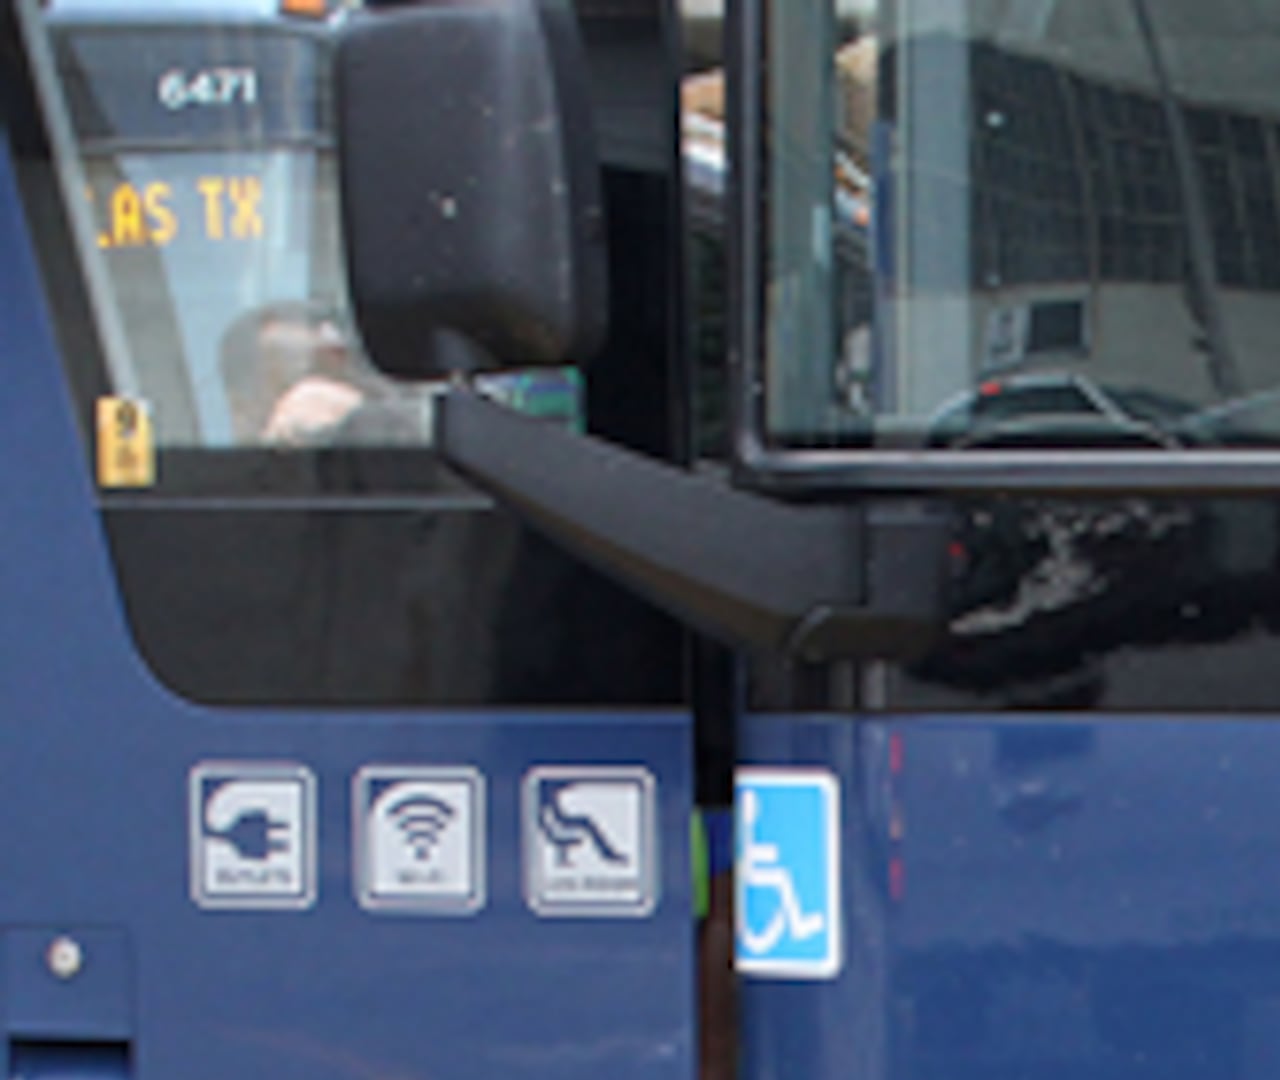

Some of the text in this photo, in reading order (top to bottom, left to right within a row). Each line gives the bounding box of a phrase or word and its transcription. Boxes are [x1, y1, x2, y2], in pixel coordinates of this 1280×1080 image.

[158, 67, 257, 110] 6471
[97, 174, 264, 248] AS TX
